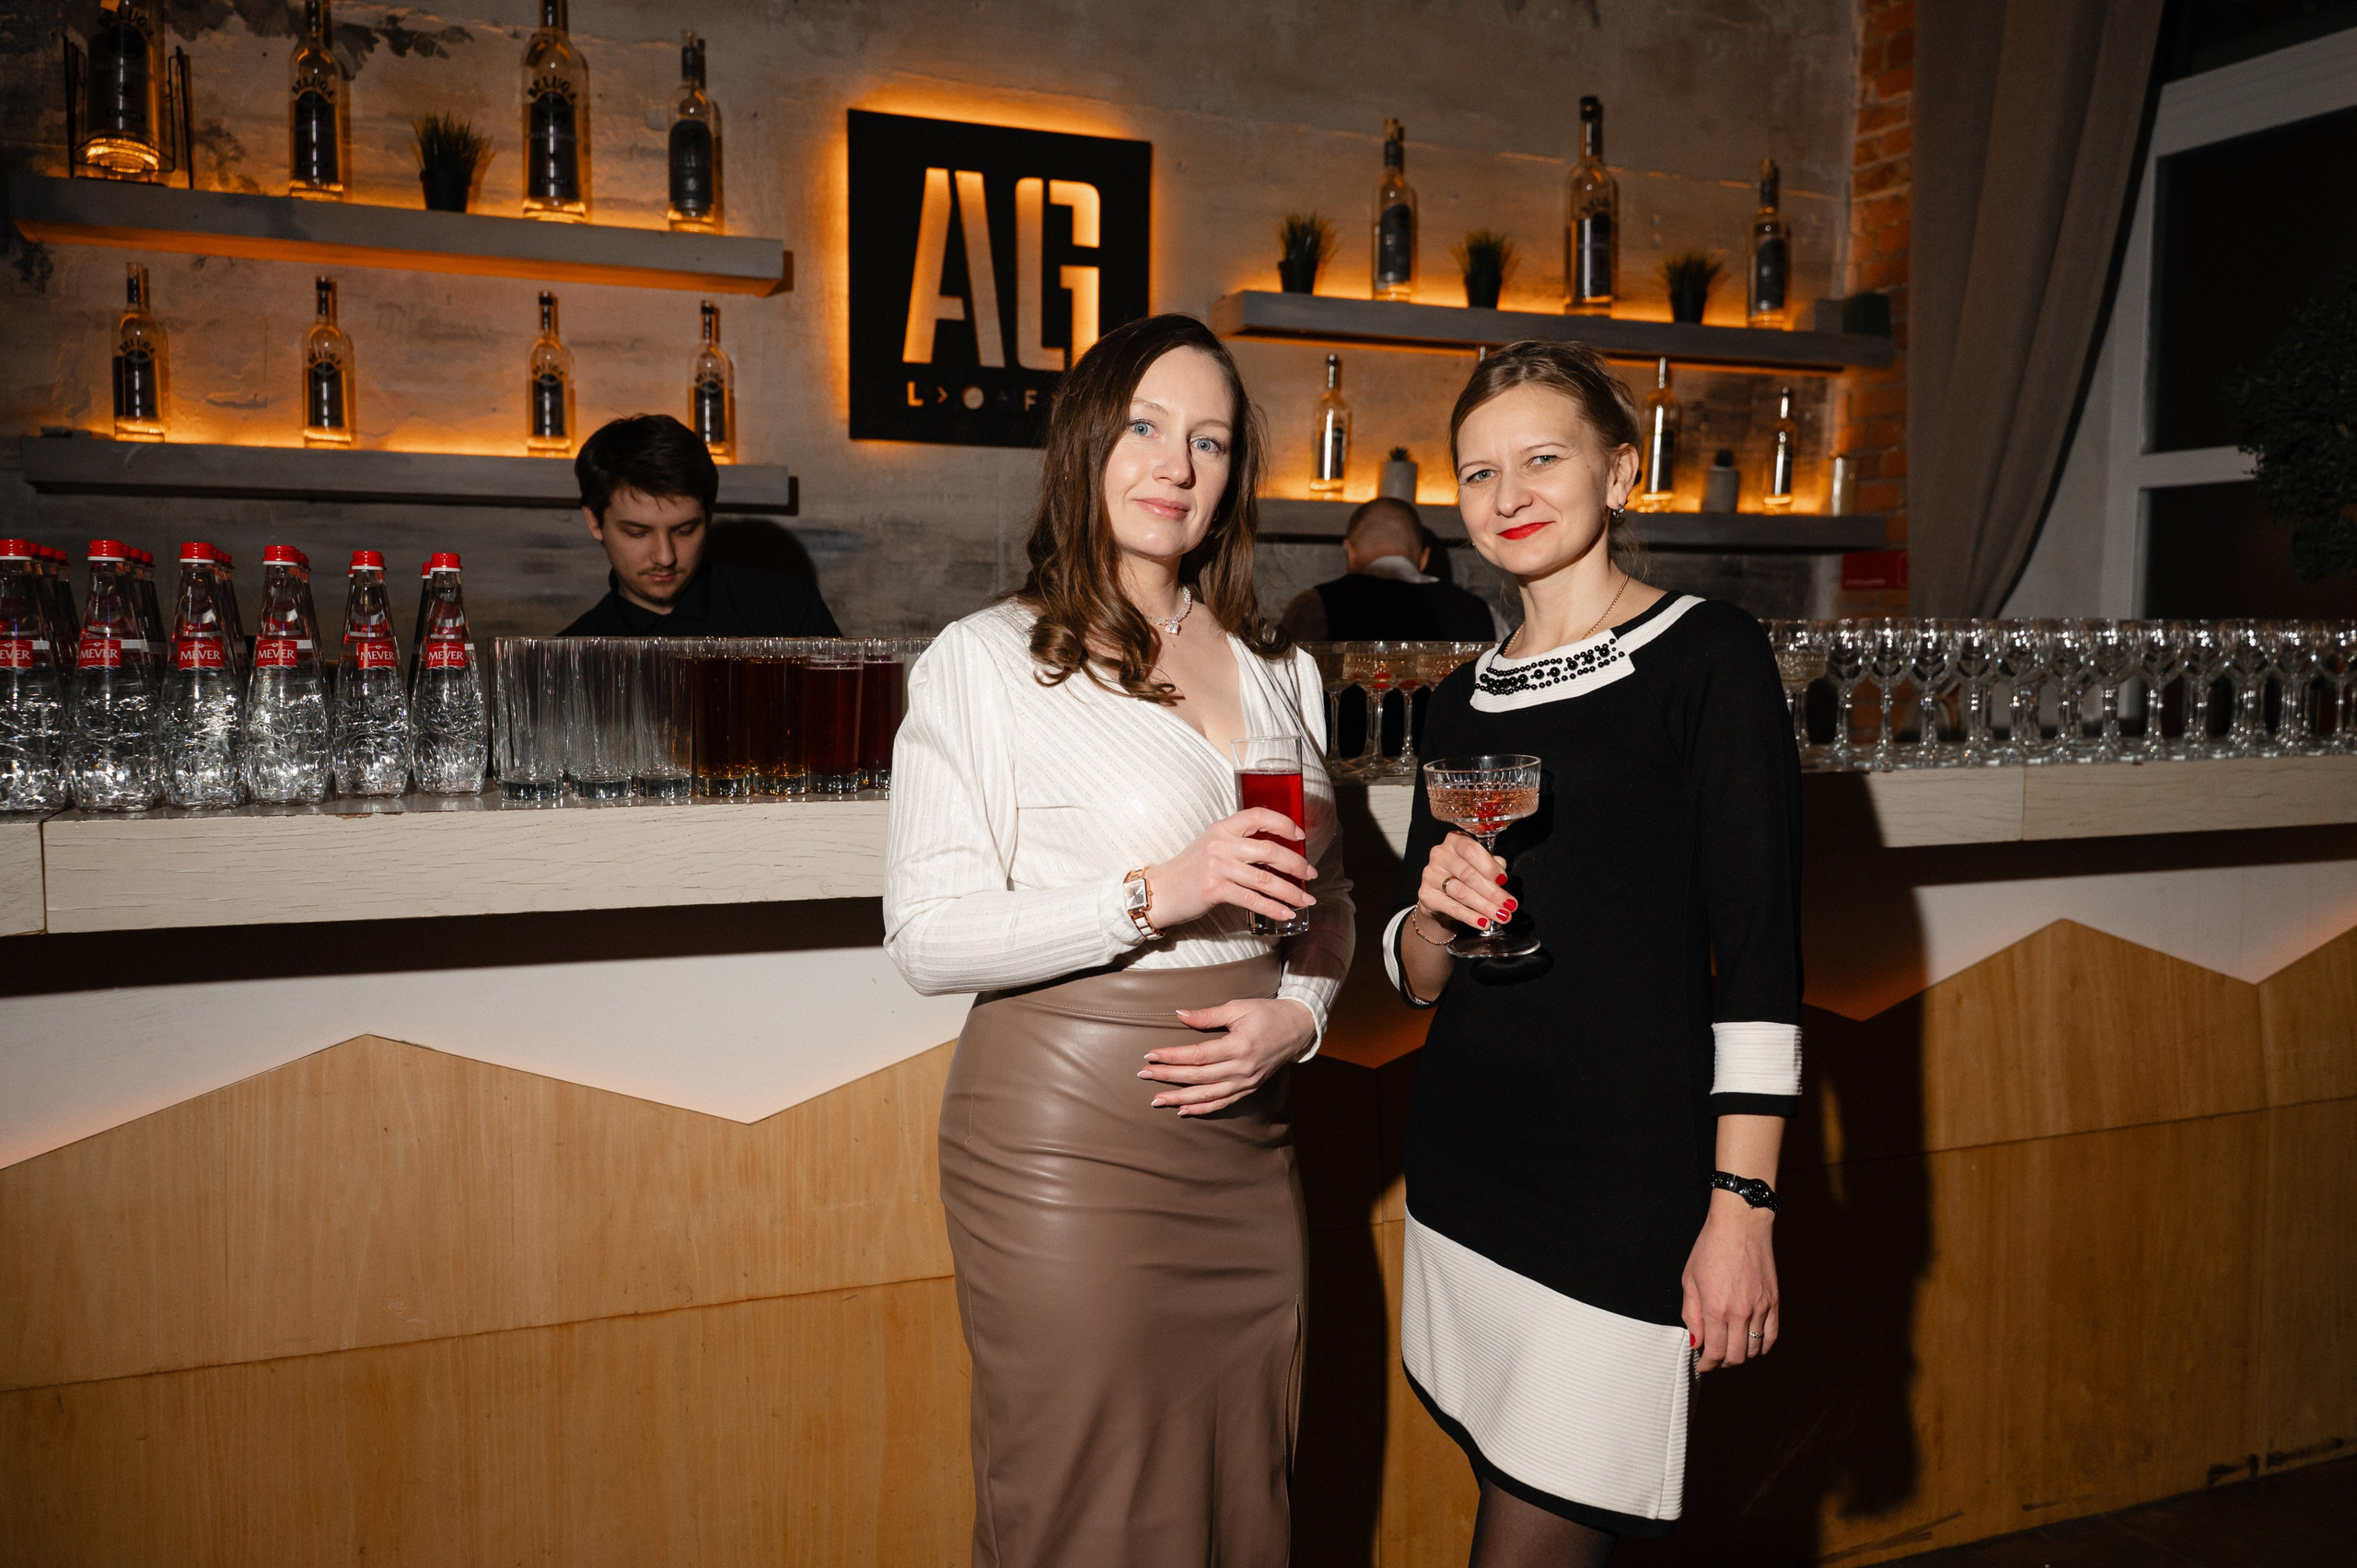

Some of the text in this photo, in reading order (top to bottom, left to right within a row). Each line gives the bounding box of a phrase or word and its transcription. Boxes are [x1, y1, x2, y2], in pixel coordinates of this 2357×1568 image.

[902, 167, 1100, 372] AG
[0, 649, 31, 660] EVER
[79, 648, 119, 659] MEVER
[180, 650, 221, 661] MEVER
[258, 649, 296, 659] MEVER
[360, 651, 396, 660] MEVER
[428, 650, 464, 661] MEVER
